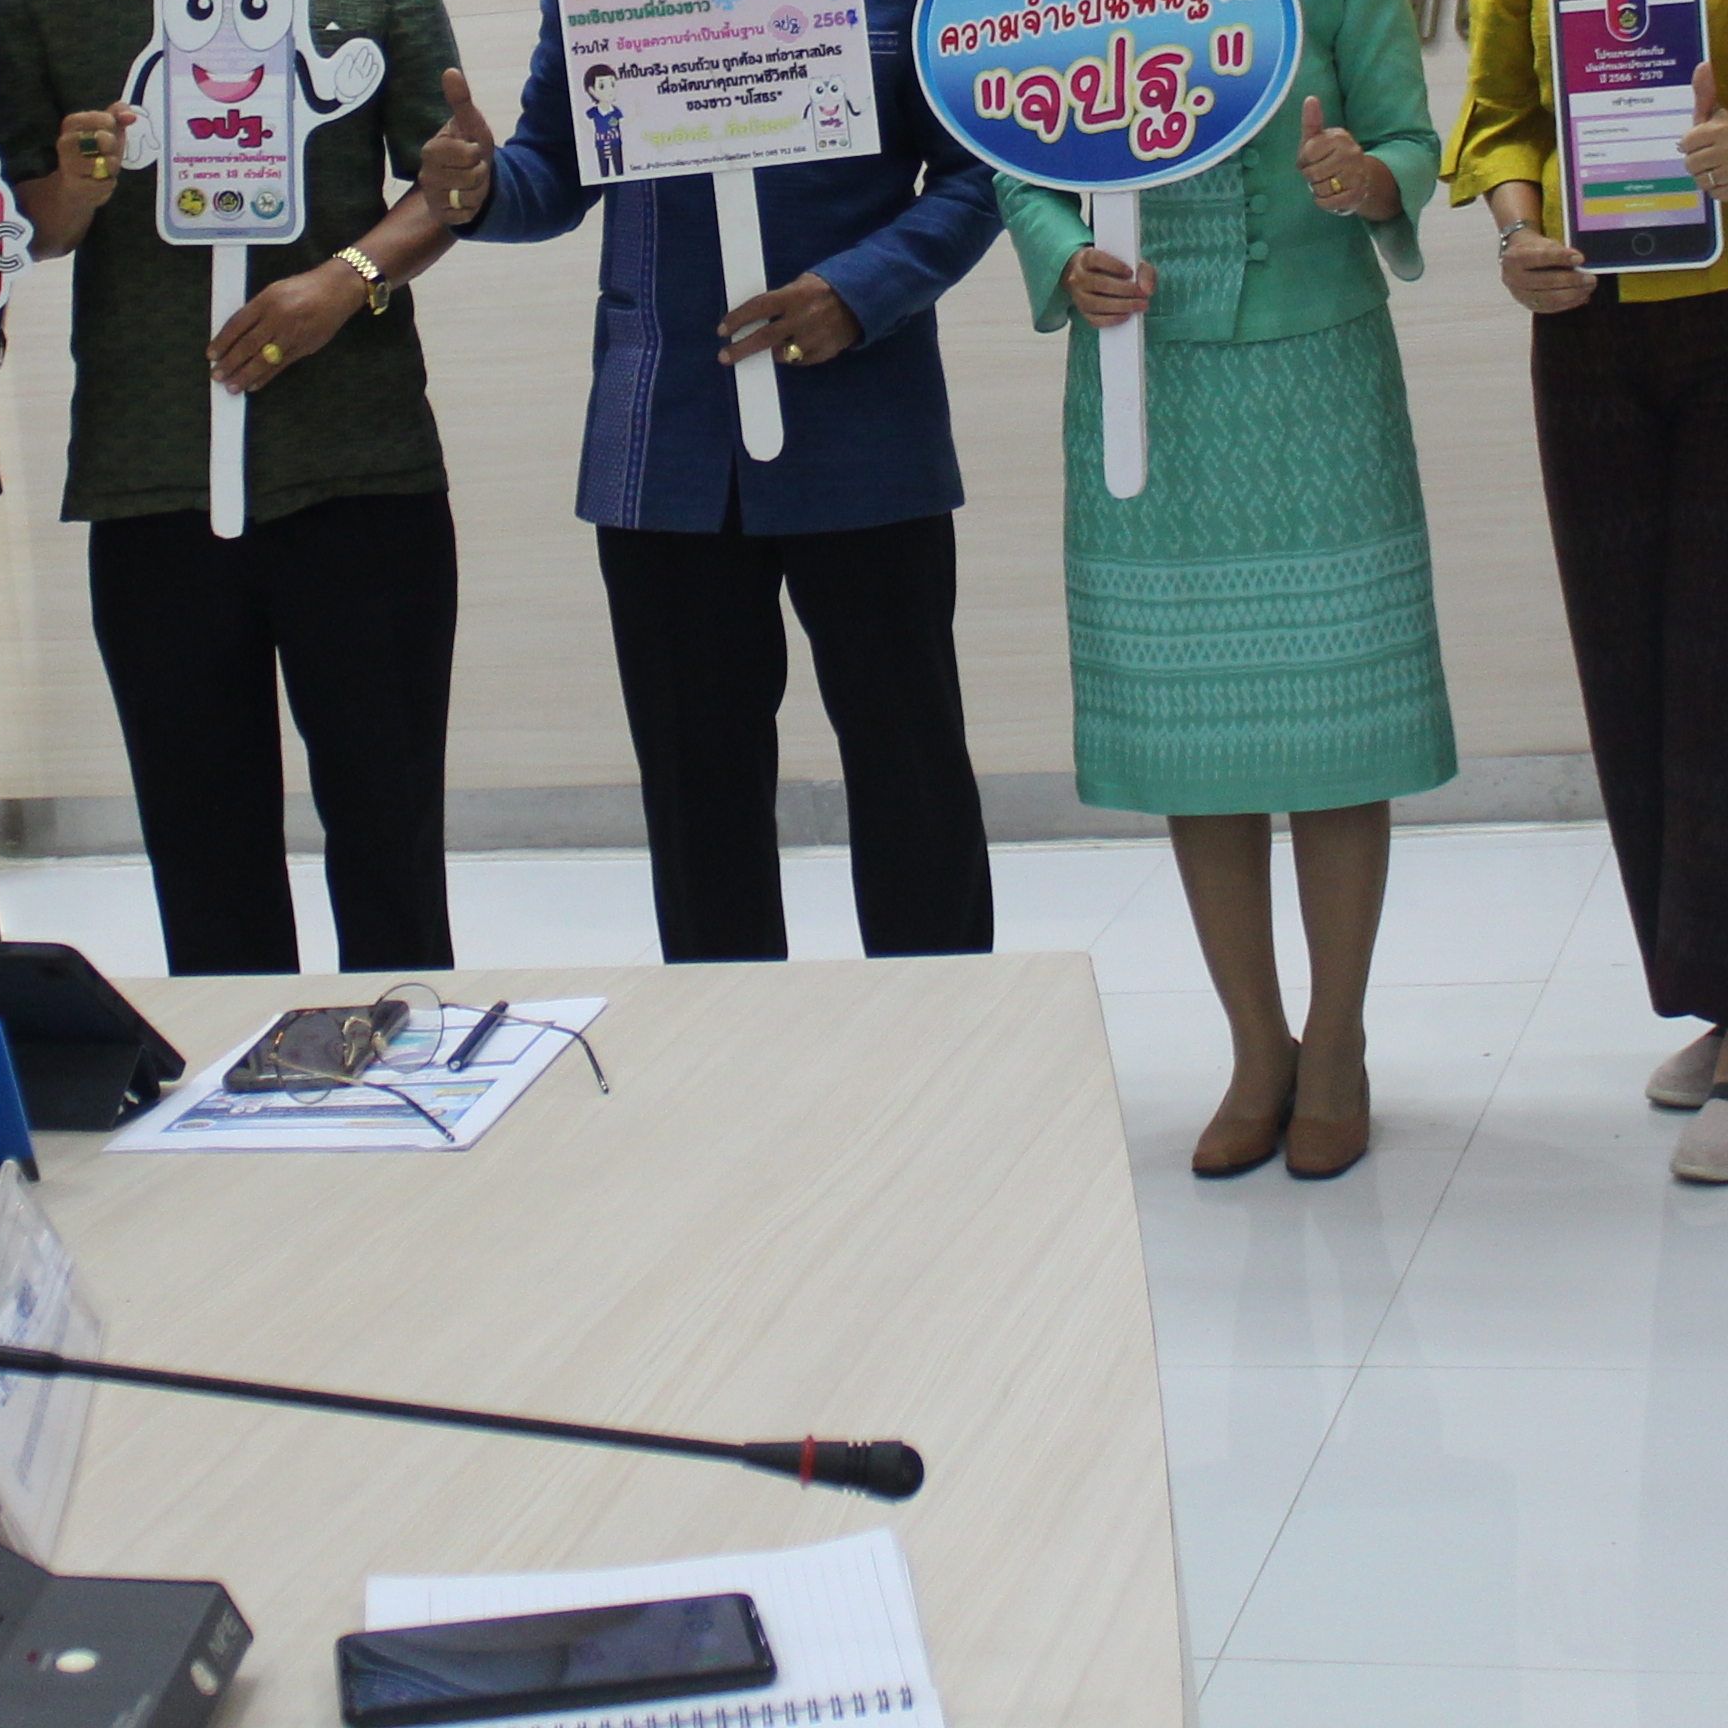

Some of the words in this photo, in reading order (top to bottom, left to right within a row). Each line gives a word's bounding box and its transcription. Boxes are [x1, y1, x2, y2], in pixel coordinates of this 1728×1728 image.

[571, 38, 610, 56] ร่วมให้
[616, 21, 765, 54] ข้อมูลความจำเป็นพื้นฐาน
[617, 60, 670, 81] ที่เป็นจริง
[672, 57, 720, 78] ครบถ้วน
[722, 50, 763, 70] ถูกต้อง
[766, 44, 842, 65] แก่อาสาสมัคร
[657, 68, 809, 97] เพื่อพัฒนาคุณภาพชีวิตที่ดี
[981, 31, 1245, 151] "จปฐ."
[686, 96, 733, 112] ของชาว
